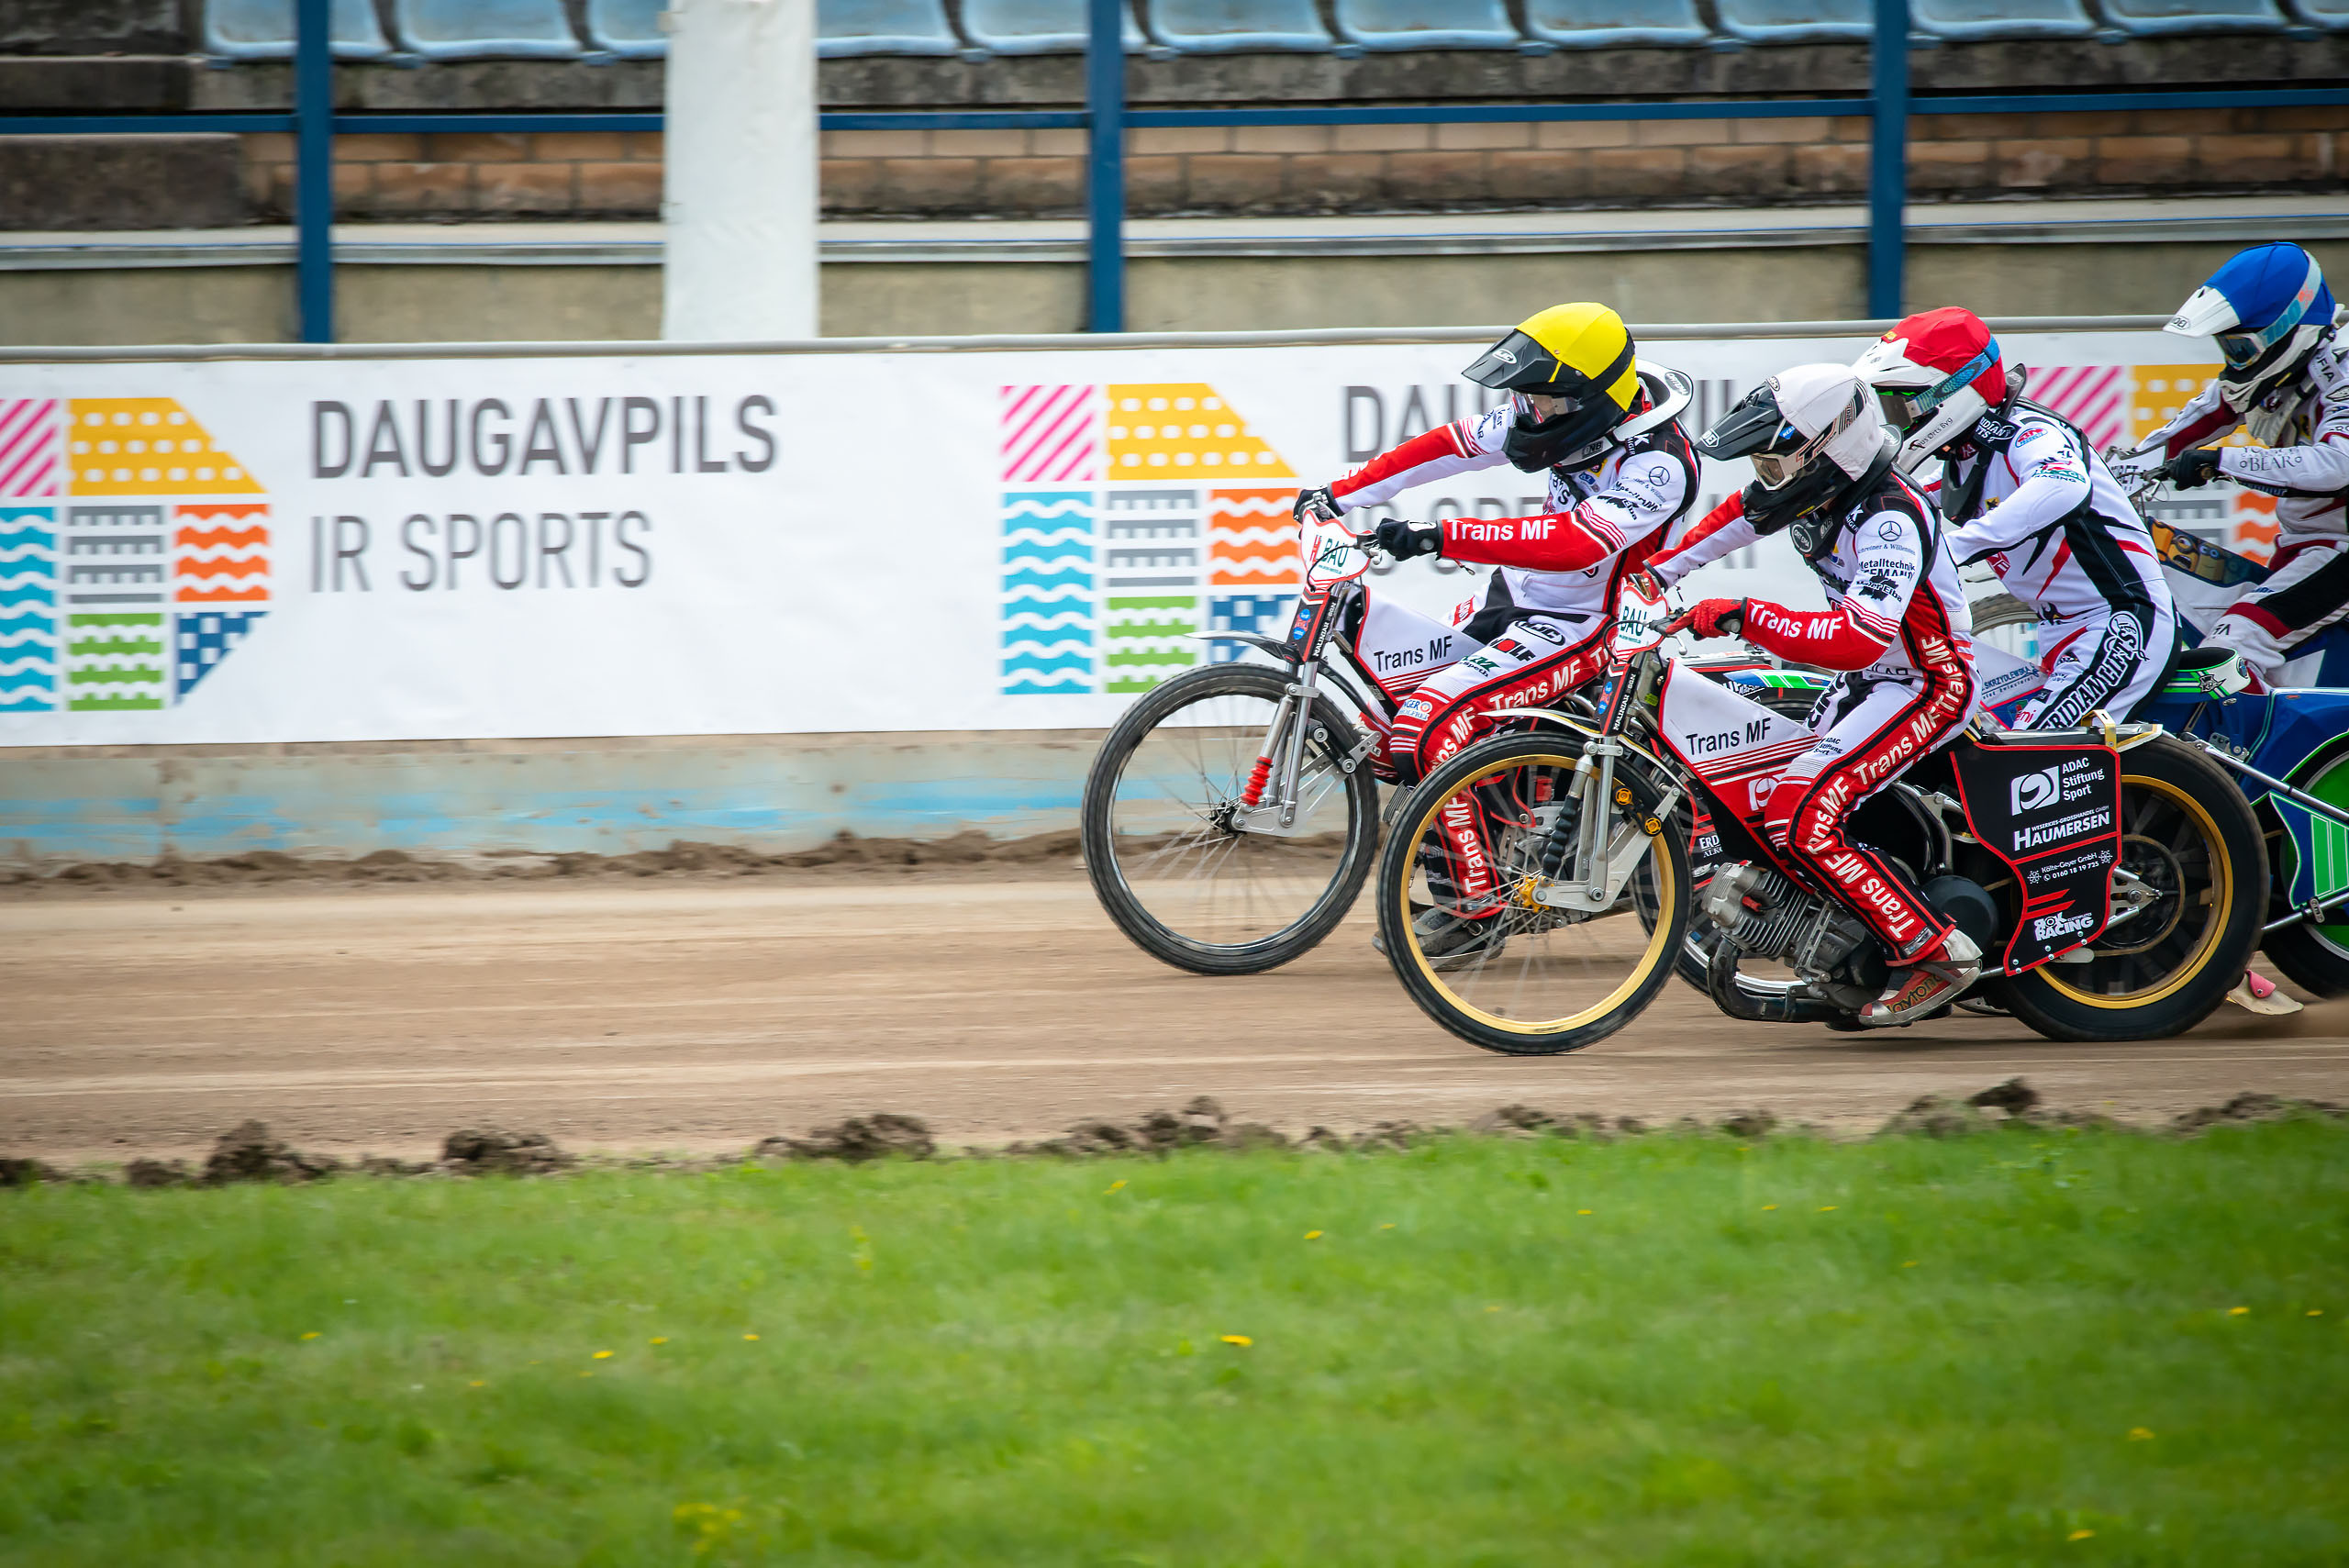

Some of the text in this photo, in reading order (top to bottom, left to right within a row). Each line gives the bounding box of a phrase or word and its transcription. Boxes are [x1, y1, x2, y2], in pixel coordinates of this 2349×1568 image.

[309, 395, 779, 479] DAUGAVPILS
[2250, 456, 2295, 472] BEAR
[1446, 519, 1557, 541] Trans MF
[309, 510, 652, 592] IR SPORTS
[1883, 584, 1902, 602] Elba
[1750, 601, 1843, 640] Trans MF
[1374, 635, 1453, 673] Trans MF
[1489, 659, 1581, 714] Trans MF
[1921, 636, 1965, 712] Trans MF
[1452, 707, 1477, 744] MF
[1686, 717, 1772, 757] Trans MF
[1854, 706, 1941, 785] Trans MF
[2062, 757, 2090, 774] ADAC
[2062, 768, 2105, 788] Stiftung
[1820, 776, 1850, 817] MF
[2063, 784, 2092, 802] Sport
[1444, 797, 1472, 828] MF
[2013, 812, 2110, 851] HAUMERSEN
[1464, 829, 1487, 893] Trans
[2052, 870, 2069, 879] 0160
[2069, 867, 2077, 875] 18
[2087, 861, 2099, 870] 725
[1824, 853, 1915, 939] Trans MF
[2034, 917, 2095, 941] RACING
